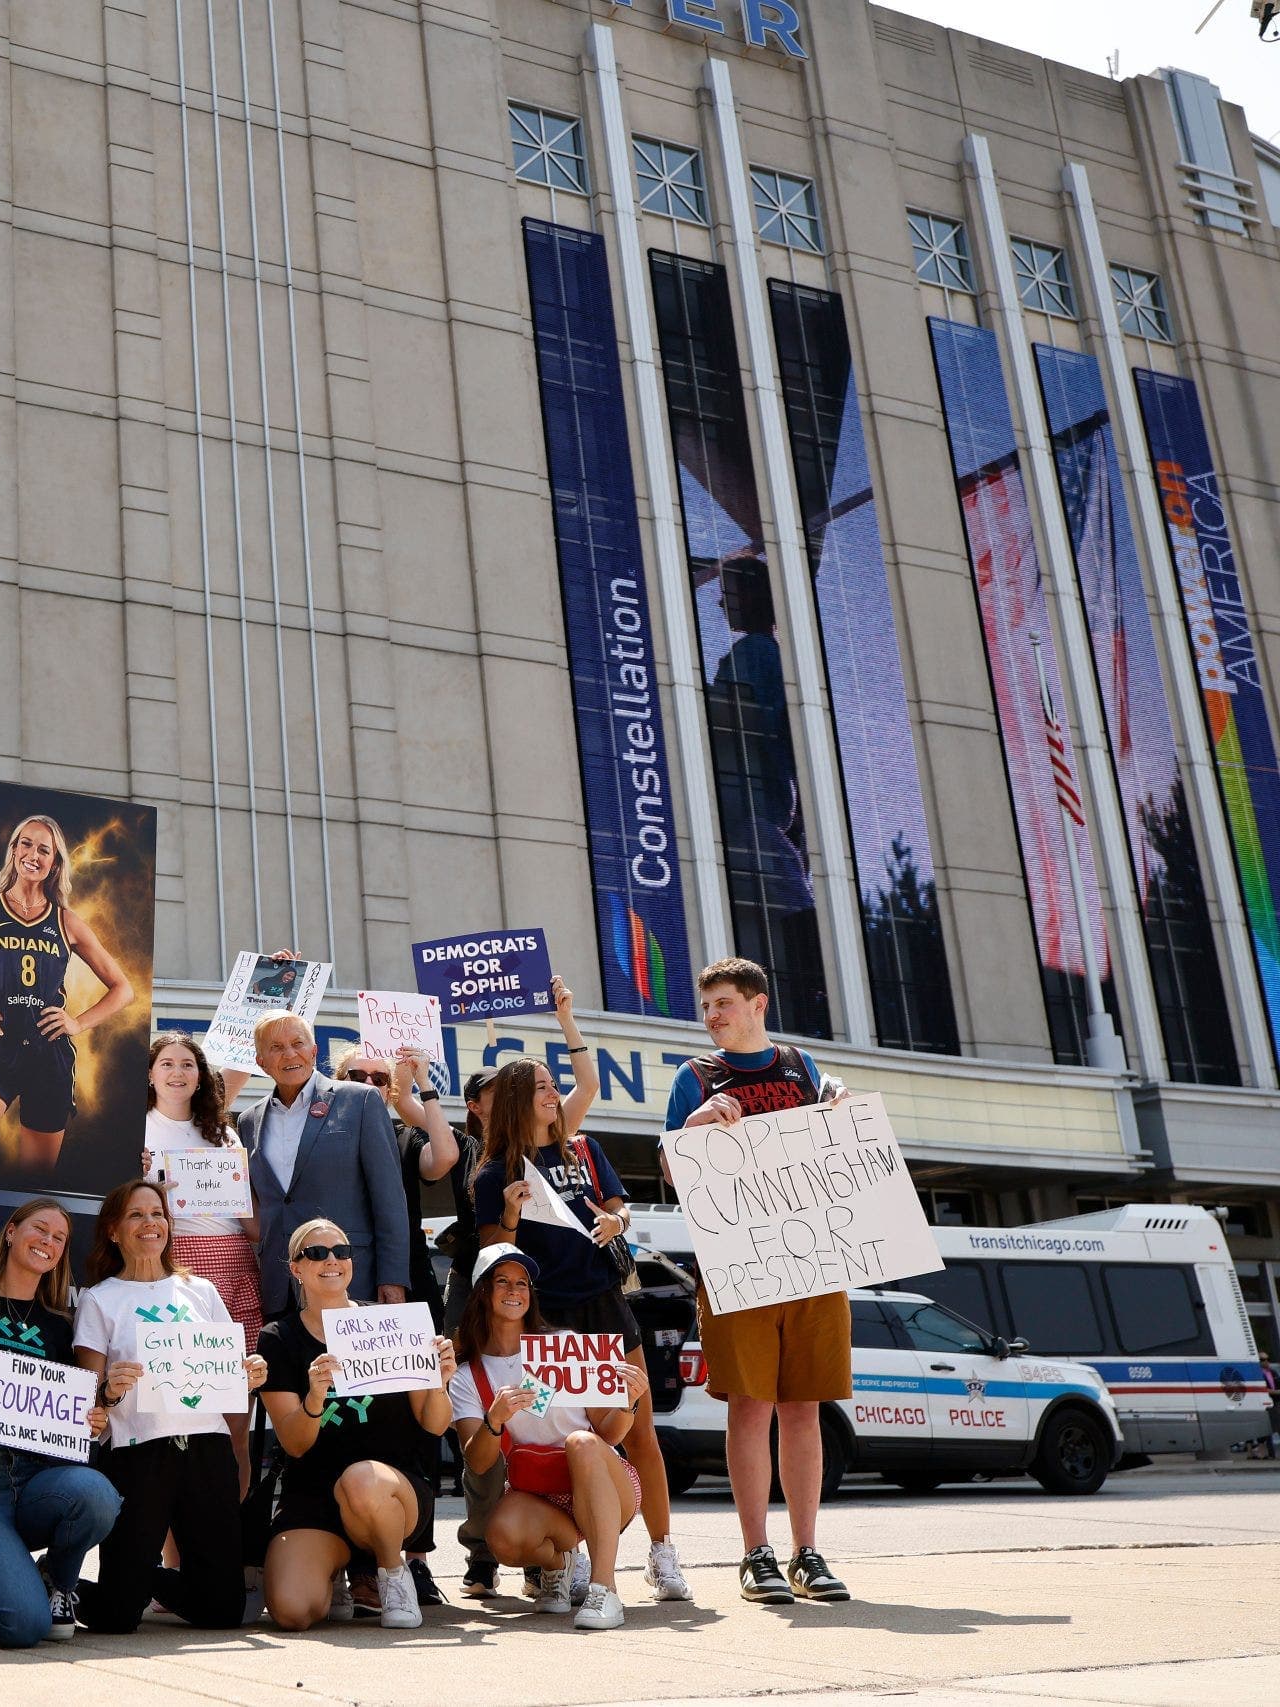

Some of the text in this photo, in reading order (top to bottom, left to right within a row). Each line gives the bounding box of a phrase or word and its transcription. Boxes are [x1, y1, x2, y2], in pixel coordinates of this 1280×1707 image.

[1186, 471, 1264, 690] AMERICA
[606, 577, 671, 888] Constellation
[422, 936, 538, 964] DEMOCRATS
[21, 954, 36, 987] 8
[463, 958, 503, 977] FOR
[450, 974, 521, 997] SOPHIE
[366, 998, 435, 1028] Protect
[450, 996, 526, 1016] DI-AG.ORG
[674, 1103, 878, 1189] SOPHIE
[178, 1158, 236, 1174] Thank you
[195, 1179, 222, 1191] Sophie
[686, 1144, 901, 1236] CUNNINGHAM
[748, 1205, 854, 1265] FOR
[969, 1234, 1105, 1255] transitchicago.com
[705, 1239, 886, 1312] PRESIDENT
[335, 1317, 402, 1336] GIRLS ARE
[351, 1332, 426, 1352] WORTHY OF
[520, 1334, 626, 1362] THANK
[12, 1359, 66, 1384] FIND YOUR
[340, 1353, 437, 1381] PROTECTION
[855, 1405, 1006, 1428] CHICAGO POLICE
[19, 1425, 37, 1441] ARE
[40, 1430, 76, 1449] WORTH
